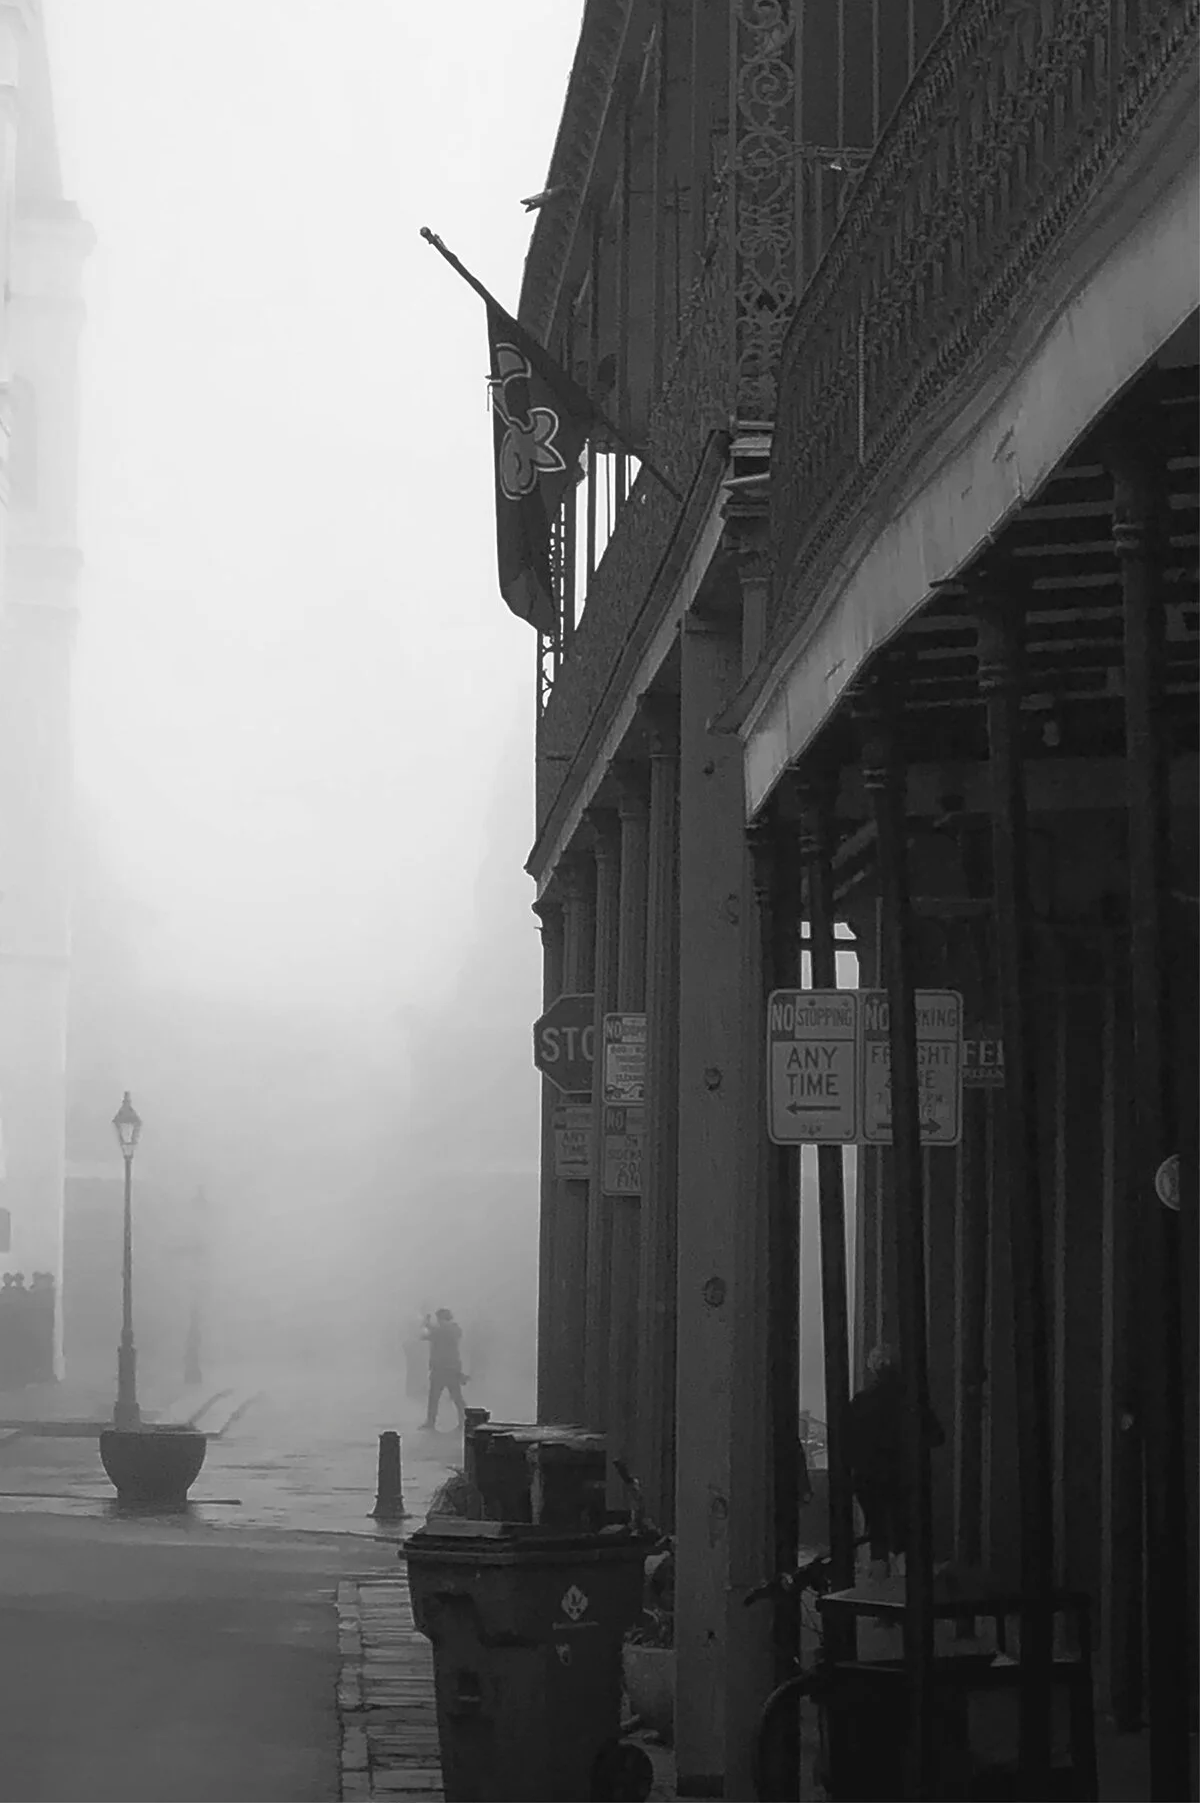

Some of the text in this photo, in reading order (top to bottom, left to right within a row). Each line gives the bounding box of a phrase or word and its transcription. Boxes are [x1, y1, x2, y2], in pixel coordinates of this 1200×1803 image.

[772, 1003, 853, 1031] NO STOPPING
[865, 1003, 890, 1031] NO
[541, 1026, 595, 1063] STO
[786, 1045, 838, 1070] ANY
[785, 1073, 840, 1097] TIME
